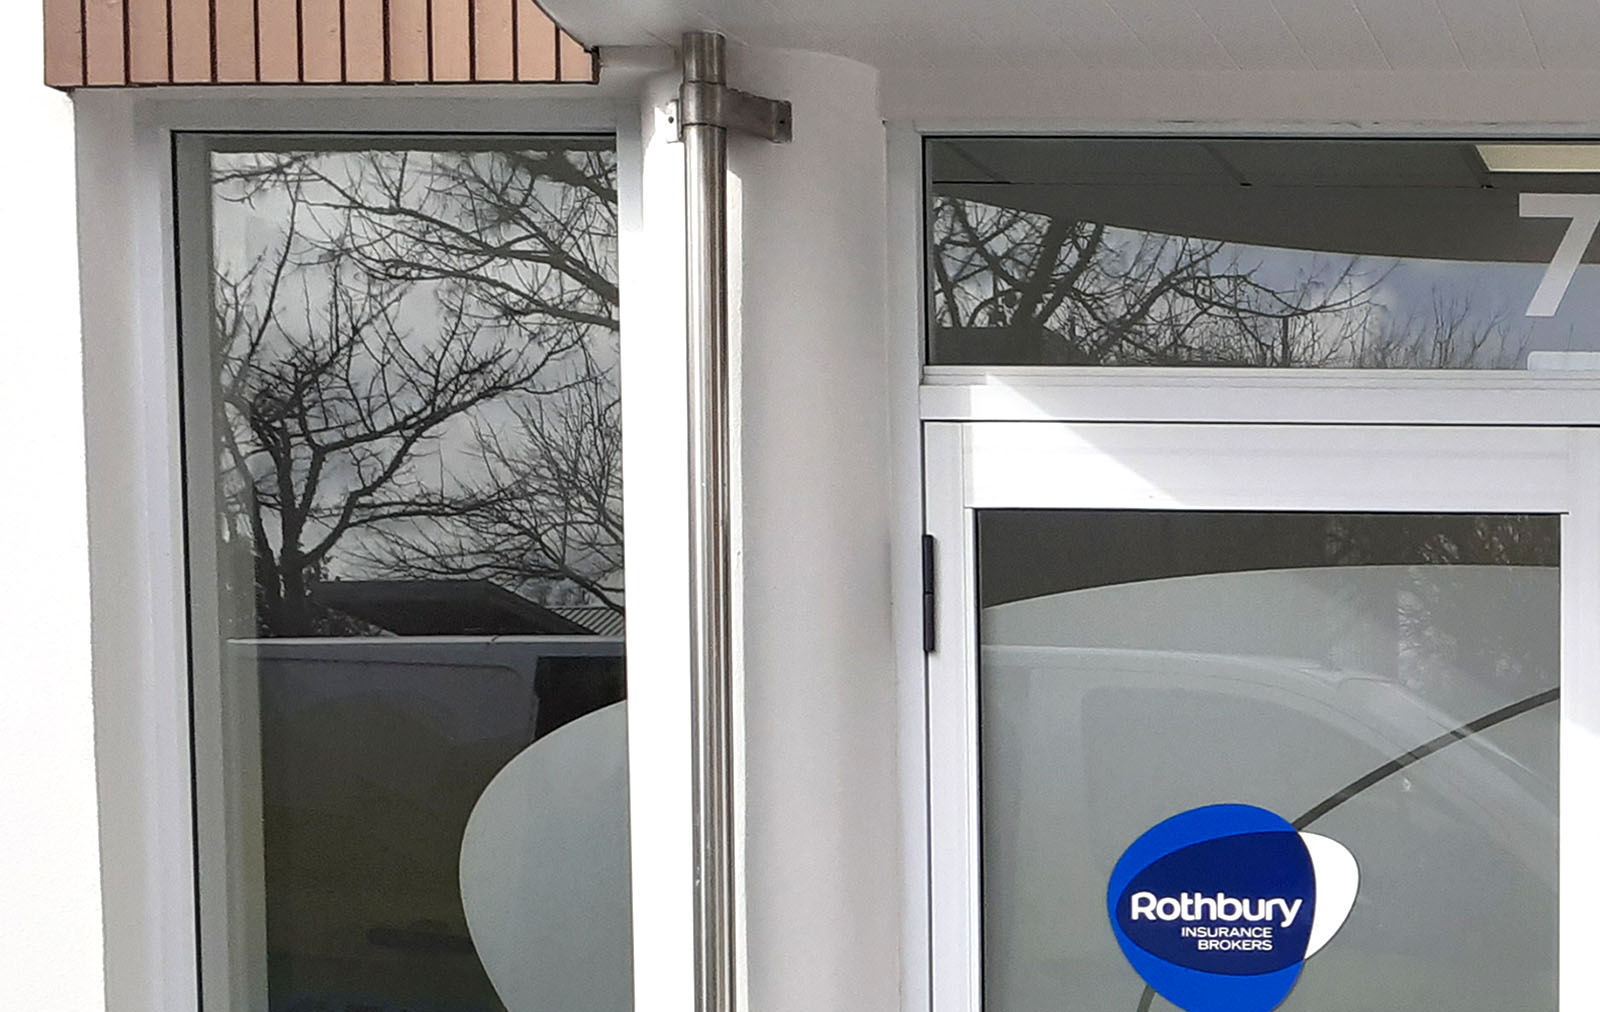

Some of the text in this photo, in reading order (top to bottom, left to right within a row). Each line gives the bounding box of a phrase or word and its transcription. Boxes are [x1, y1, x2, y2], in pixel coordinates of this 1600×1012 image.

[1131, 891, 1303, 928] Rothbury
[1180, 926, 1273, 938] INSURANCE
[1197, 939, 1273, 951] BROKERS
